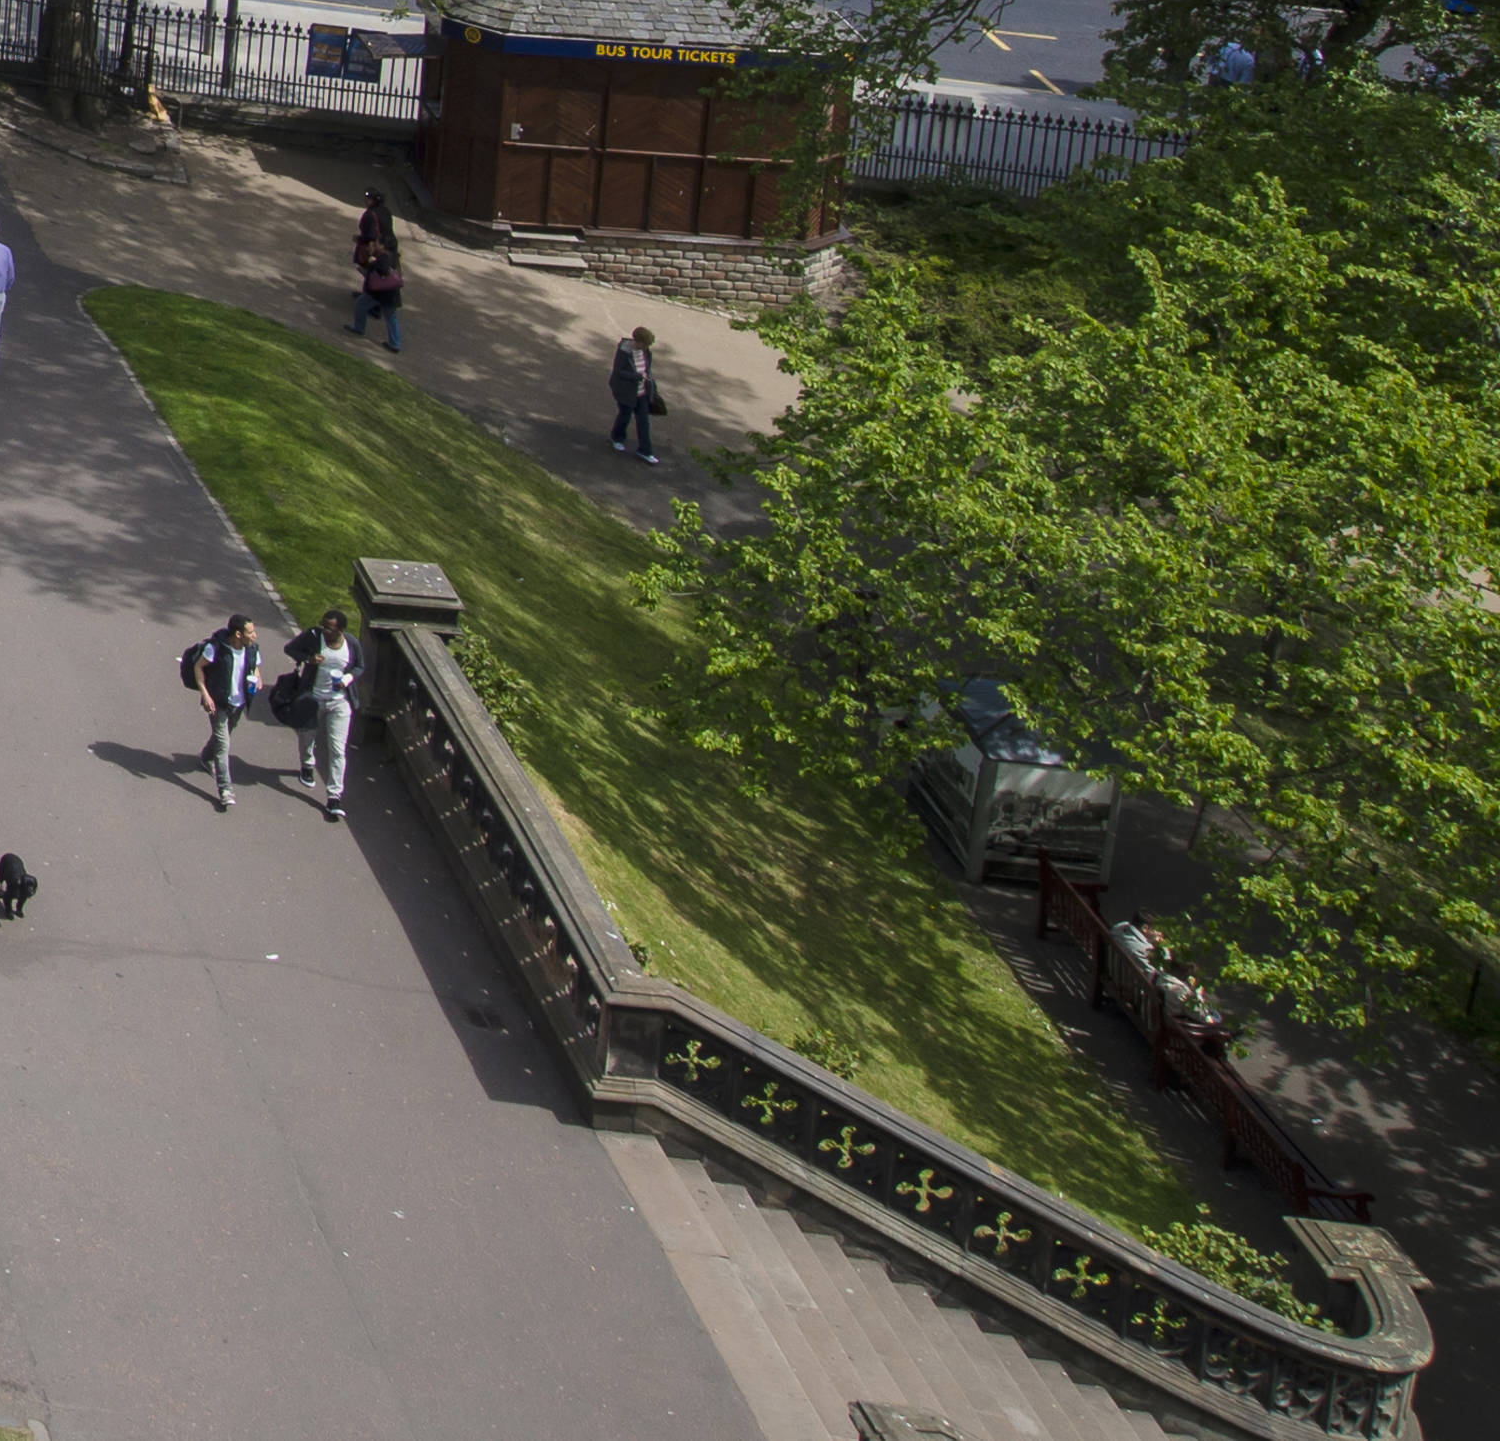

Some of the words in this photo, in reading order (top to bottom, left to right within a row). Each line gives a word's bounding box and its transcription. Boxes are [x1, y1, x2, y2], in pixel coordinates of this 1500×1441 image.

[595, 44, 627, 58] BUS
[631, 45, 673, 61] TOUR
[677, 49, 737, 65] TICKETS
